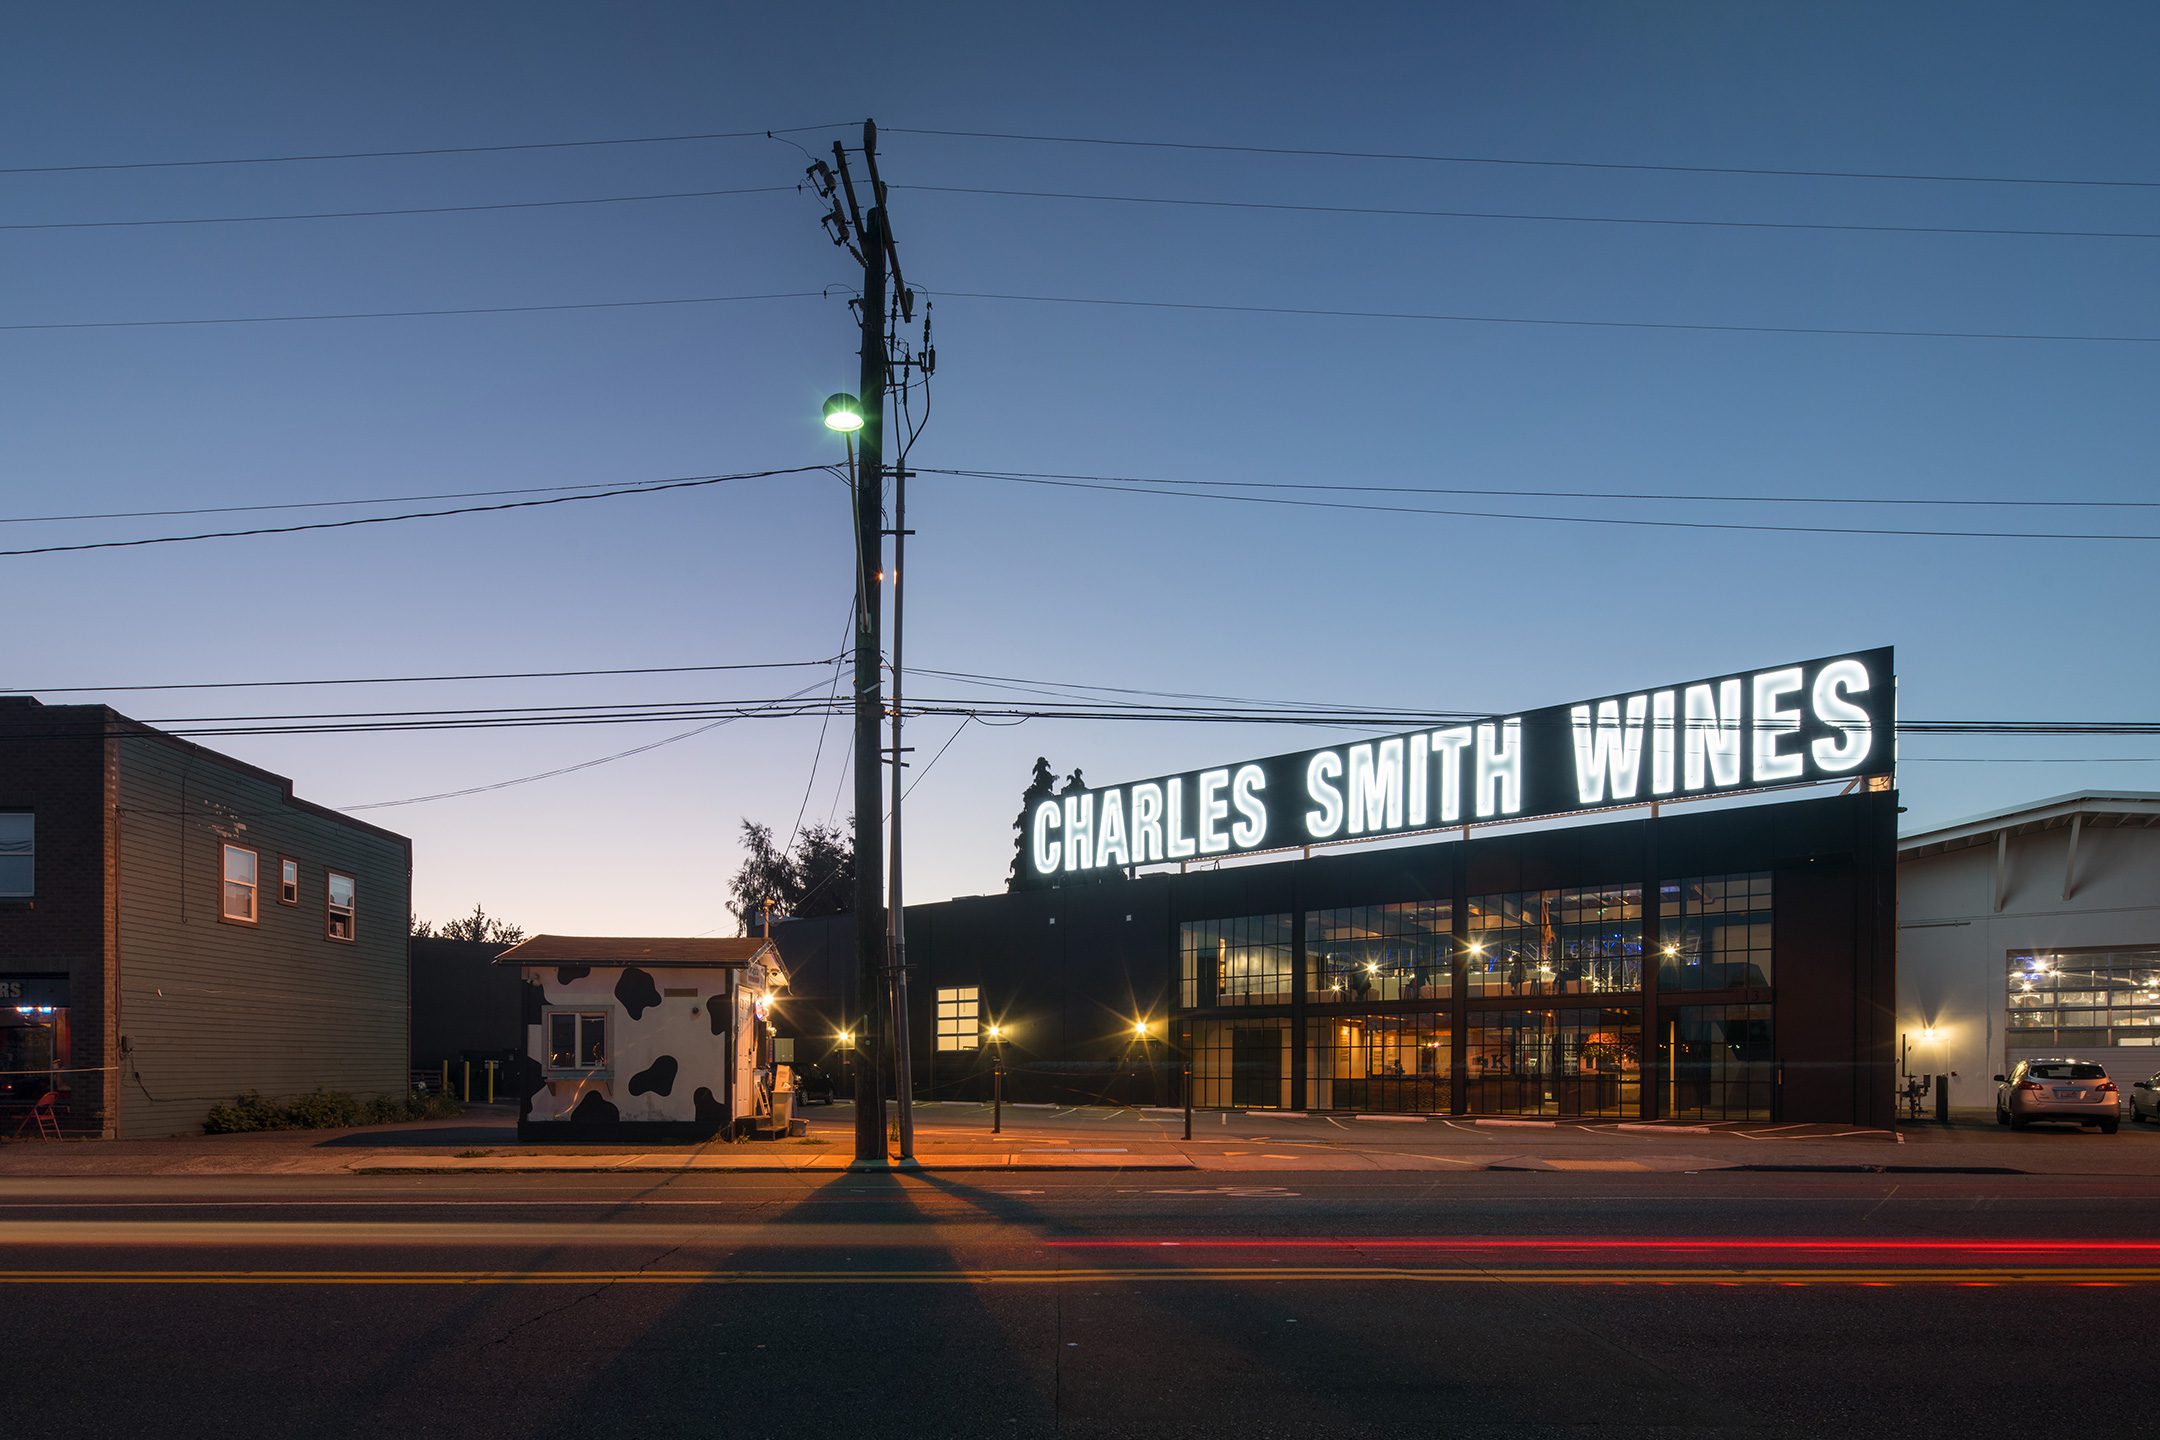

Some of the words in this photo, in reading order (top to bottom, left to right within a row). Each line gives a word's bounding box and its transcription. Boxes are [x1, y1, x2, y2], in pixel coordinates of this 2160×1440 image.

[1033, 764, 1267, 874] CHARLES
[1306, 717, 1521, 838] SMITH
[1571, 659, 1872, 804] WINES
